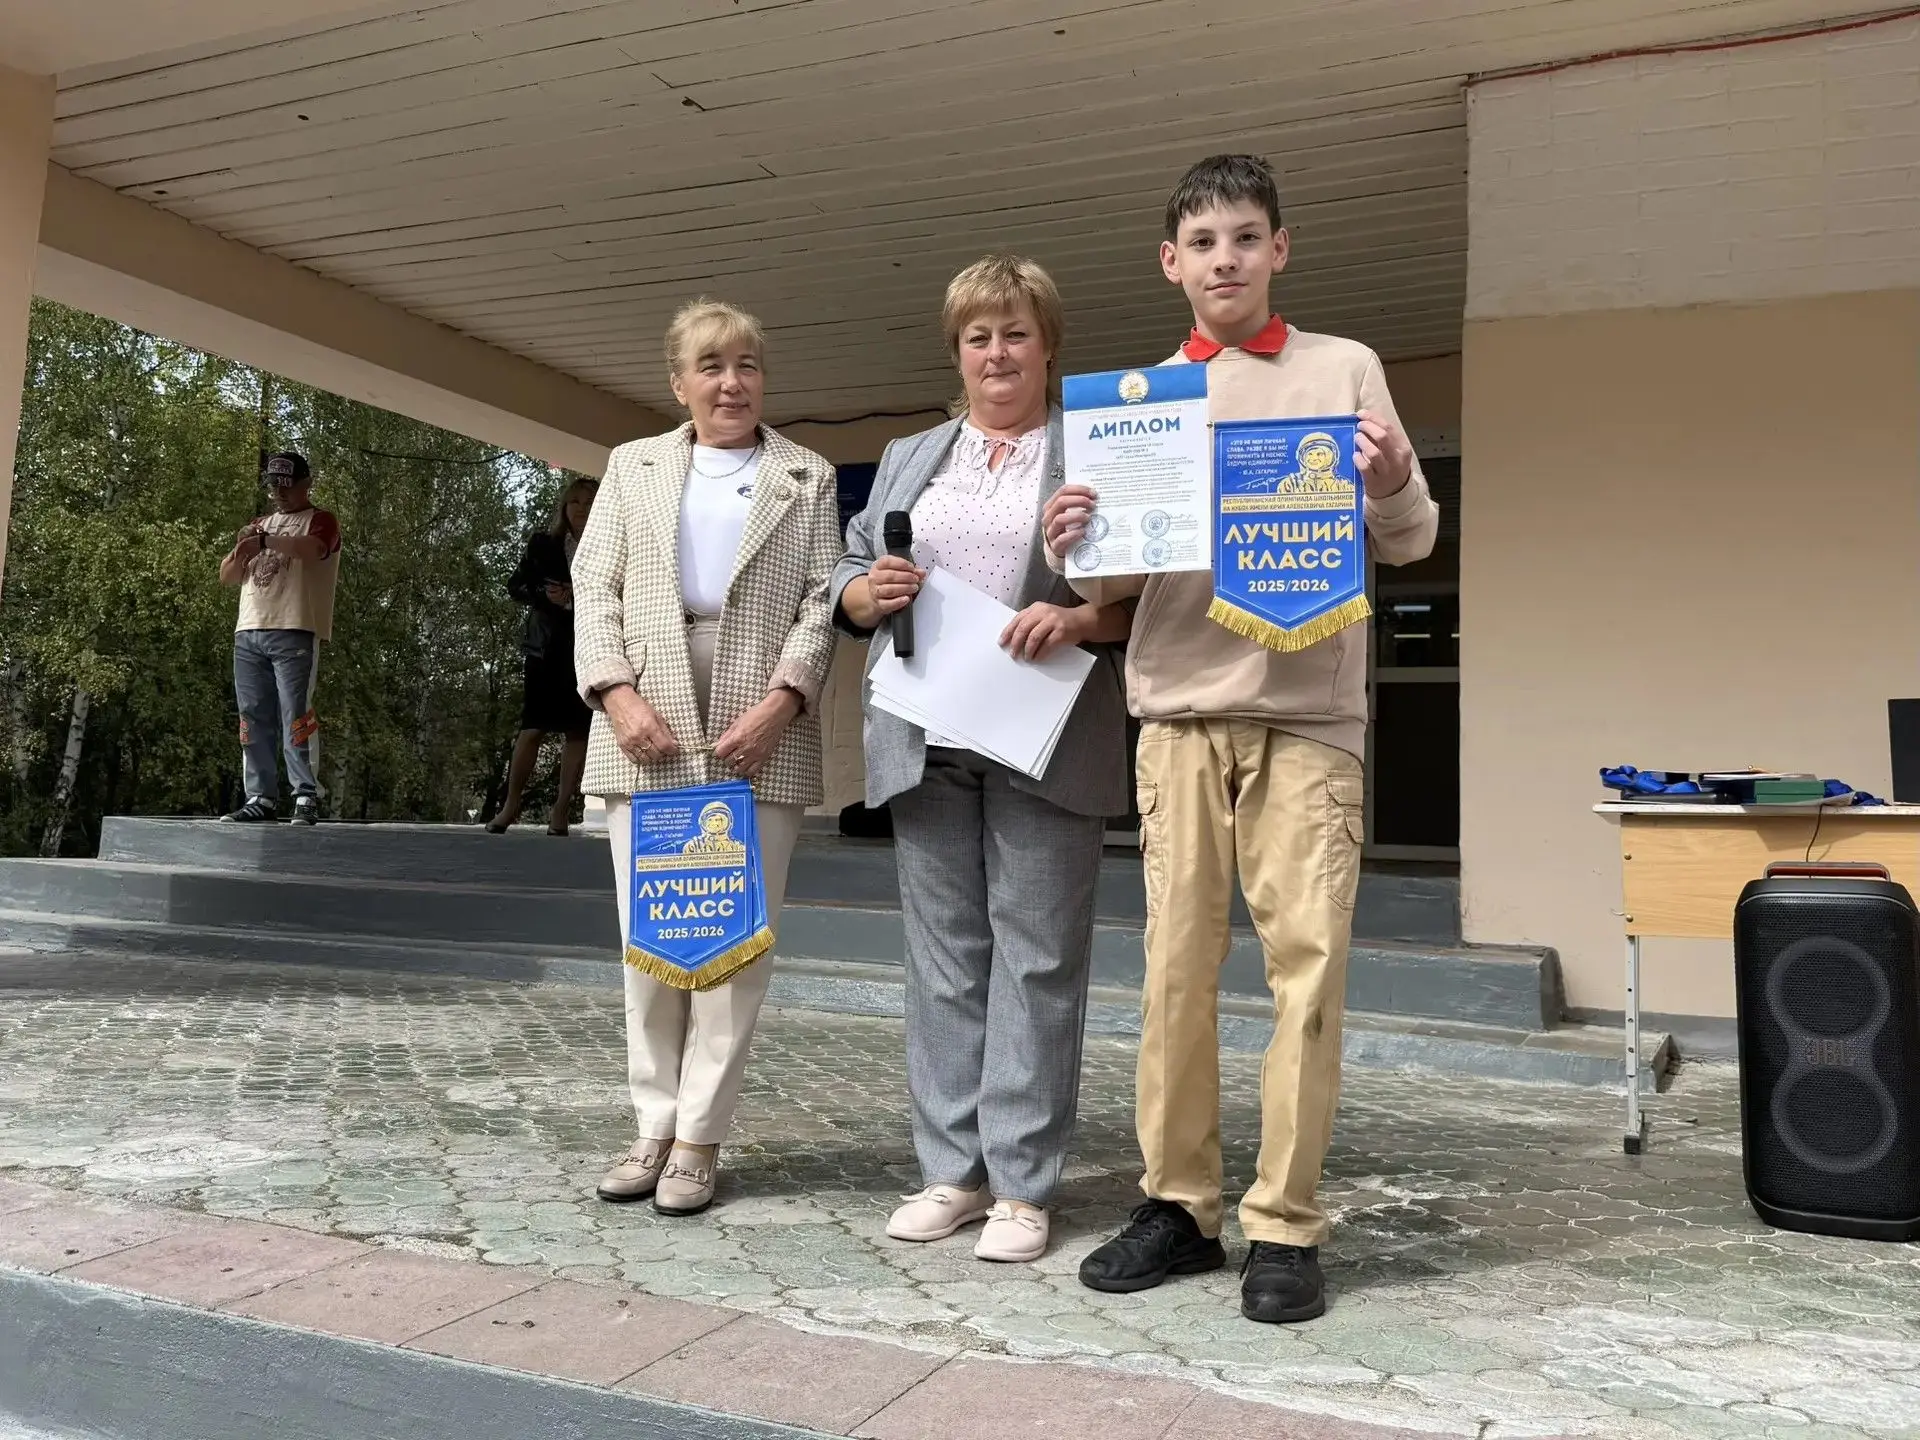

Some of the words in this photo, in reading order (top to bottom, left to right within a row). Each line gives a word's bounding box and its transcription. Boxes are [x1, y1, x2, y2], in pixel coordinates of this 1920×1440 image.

[1088, 416, 1181, 440] ДИПЛОМ
[1223, 515, 1354, 544] ЛУЧШИЙ
[1237, 548, 1342, 570] КЛАСС
[1248, 578, 1330, 592] 2025/2026
[638, 871, 744, 898] ЛУЧШИЙ
[649, 899, 735, 921] КЛАСС
[657, 926, 725, 940] 2025/2026
[1805, 1038, 1854, 1066] JBL
